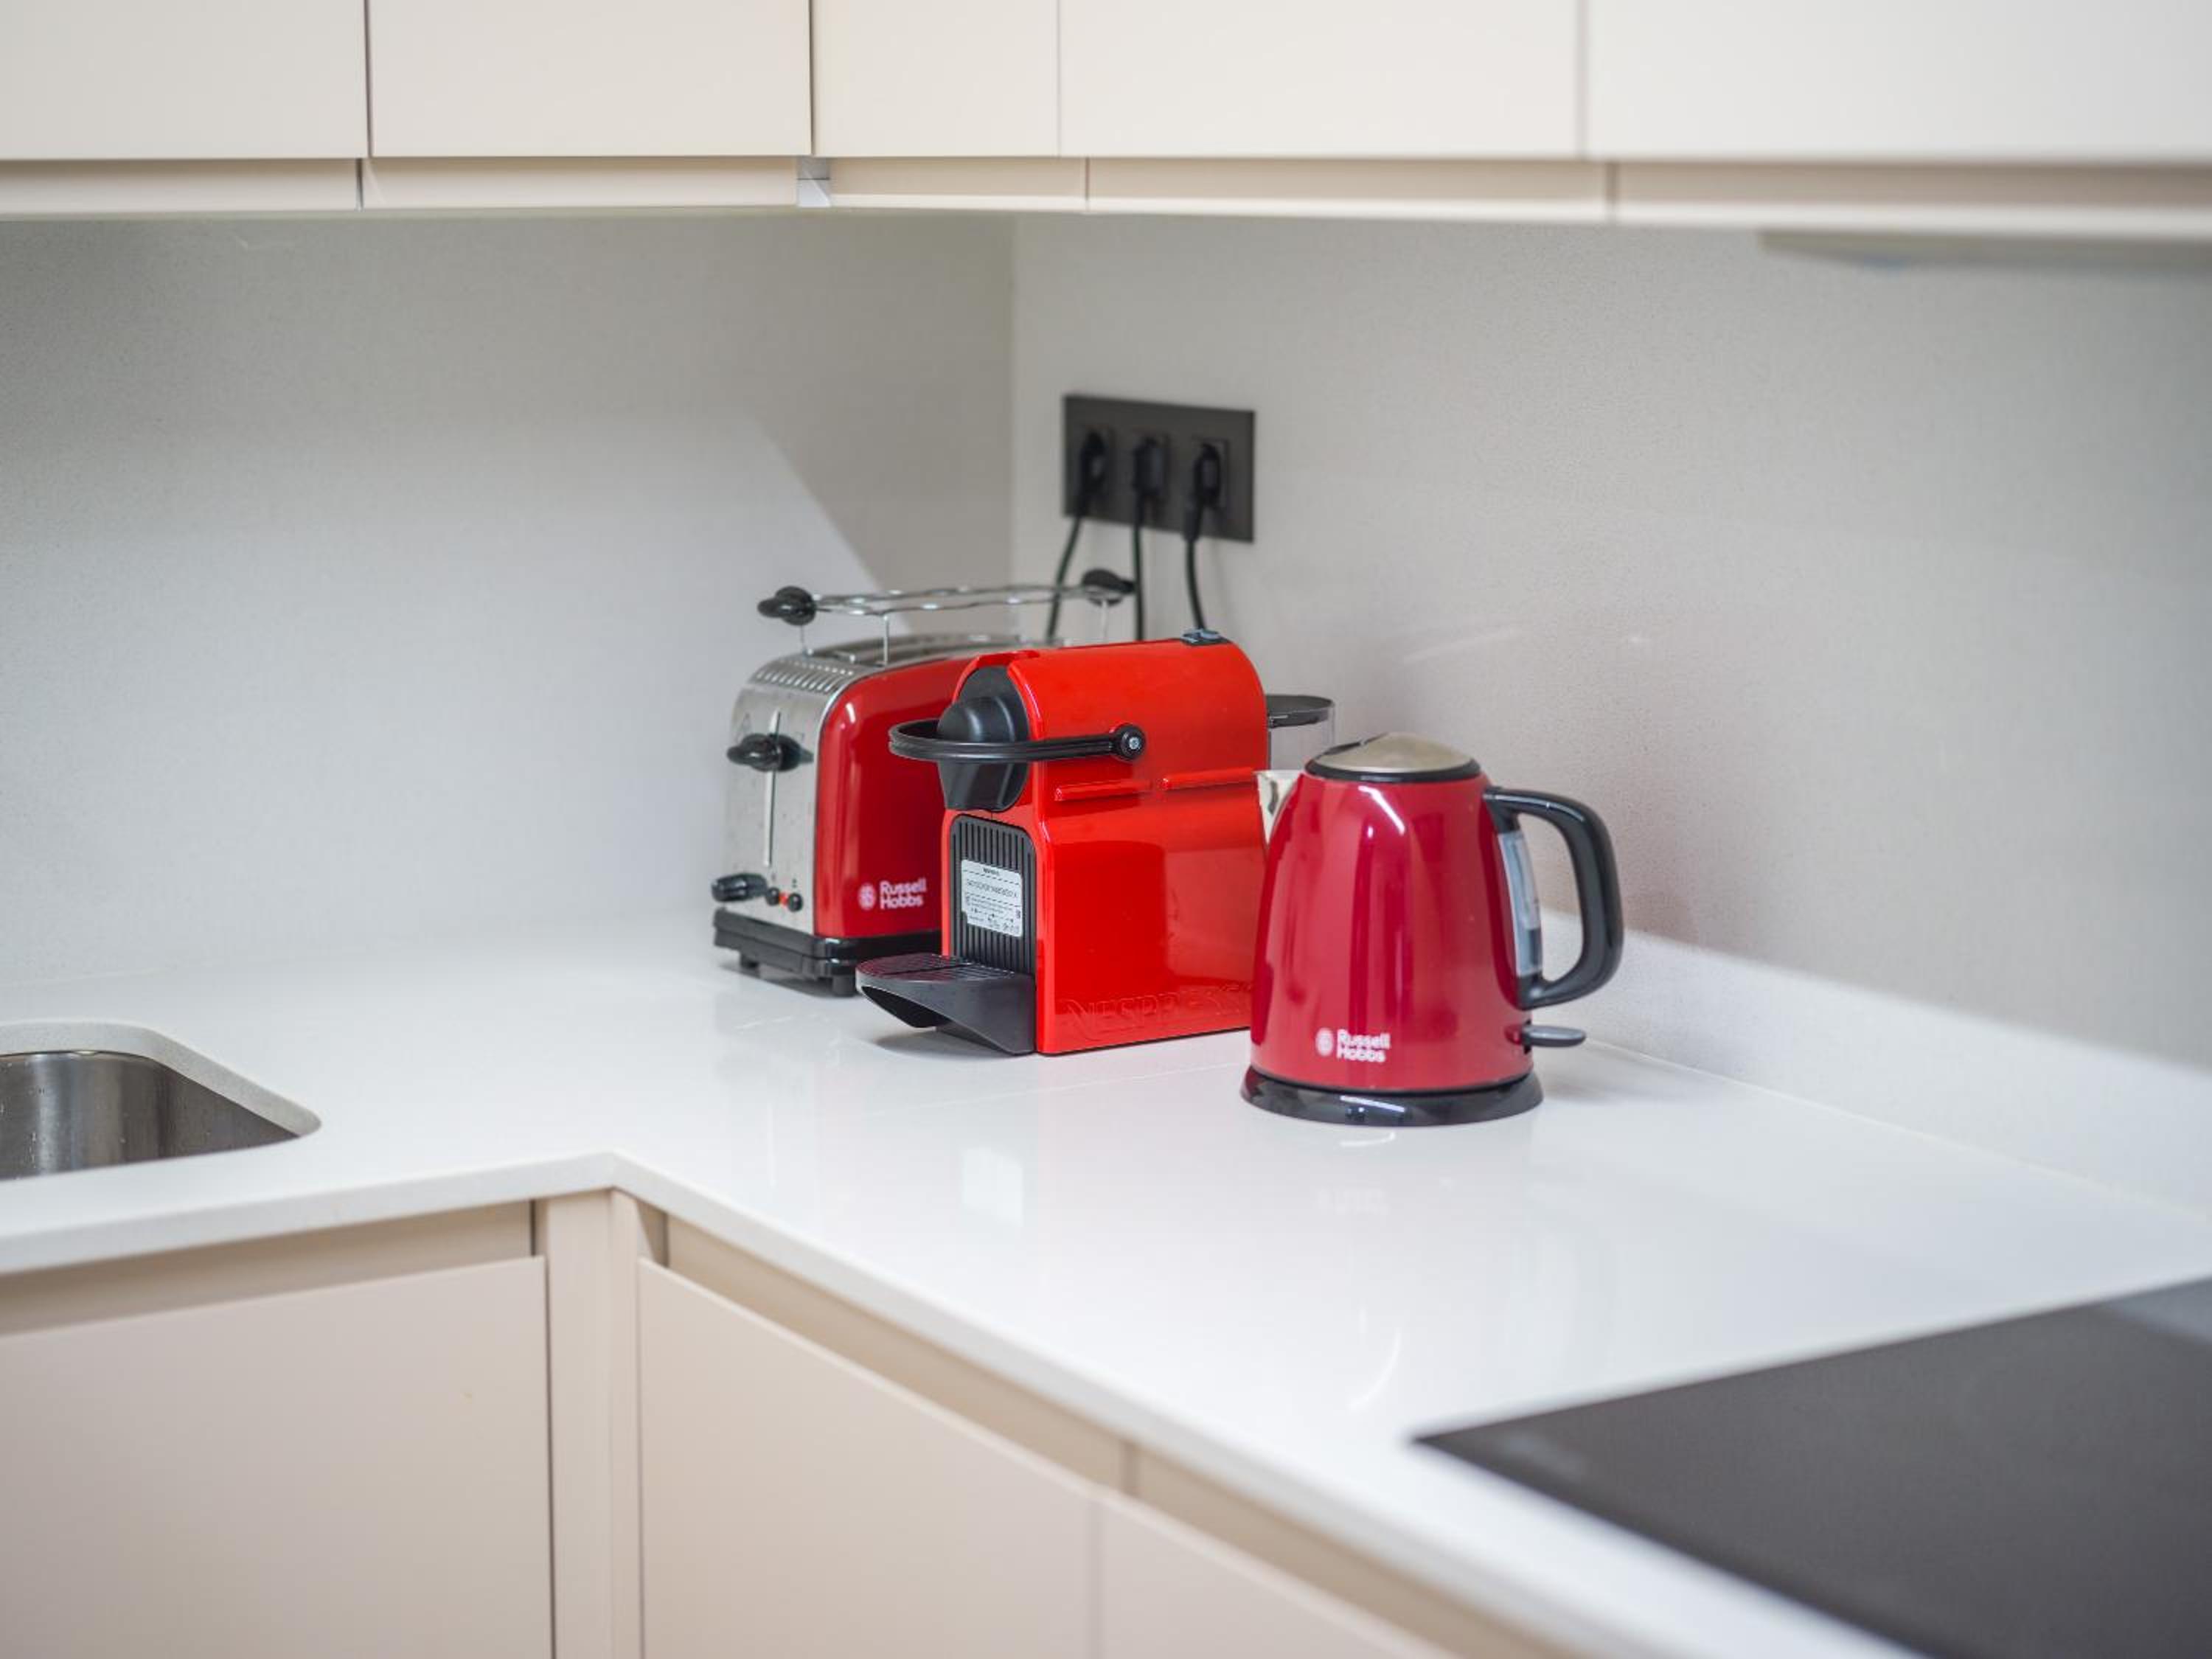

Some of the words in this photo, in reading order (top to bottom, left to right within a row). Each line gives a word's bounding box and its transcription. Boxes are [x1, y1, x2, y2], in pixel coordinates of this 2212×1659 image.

[880, 877, 926, 895] Russell
[880, 894, 923, 909] Hobbs
[1337, 1029, 1391, 1048] Russell
[1336, 1044, 1386, 1062] Hobbs
